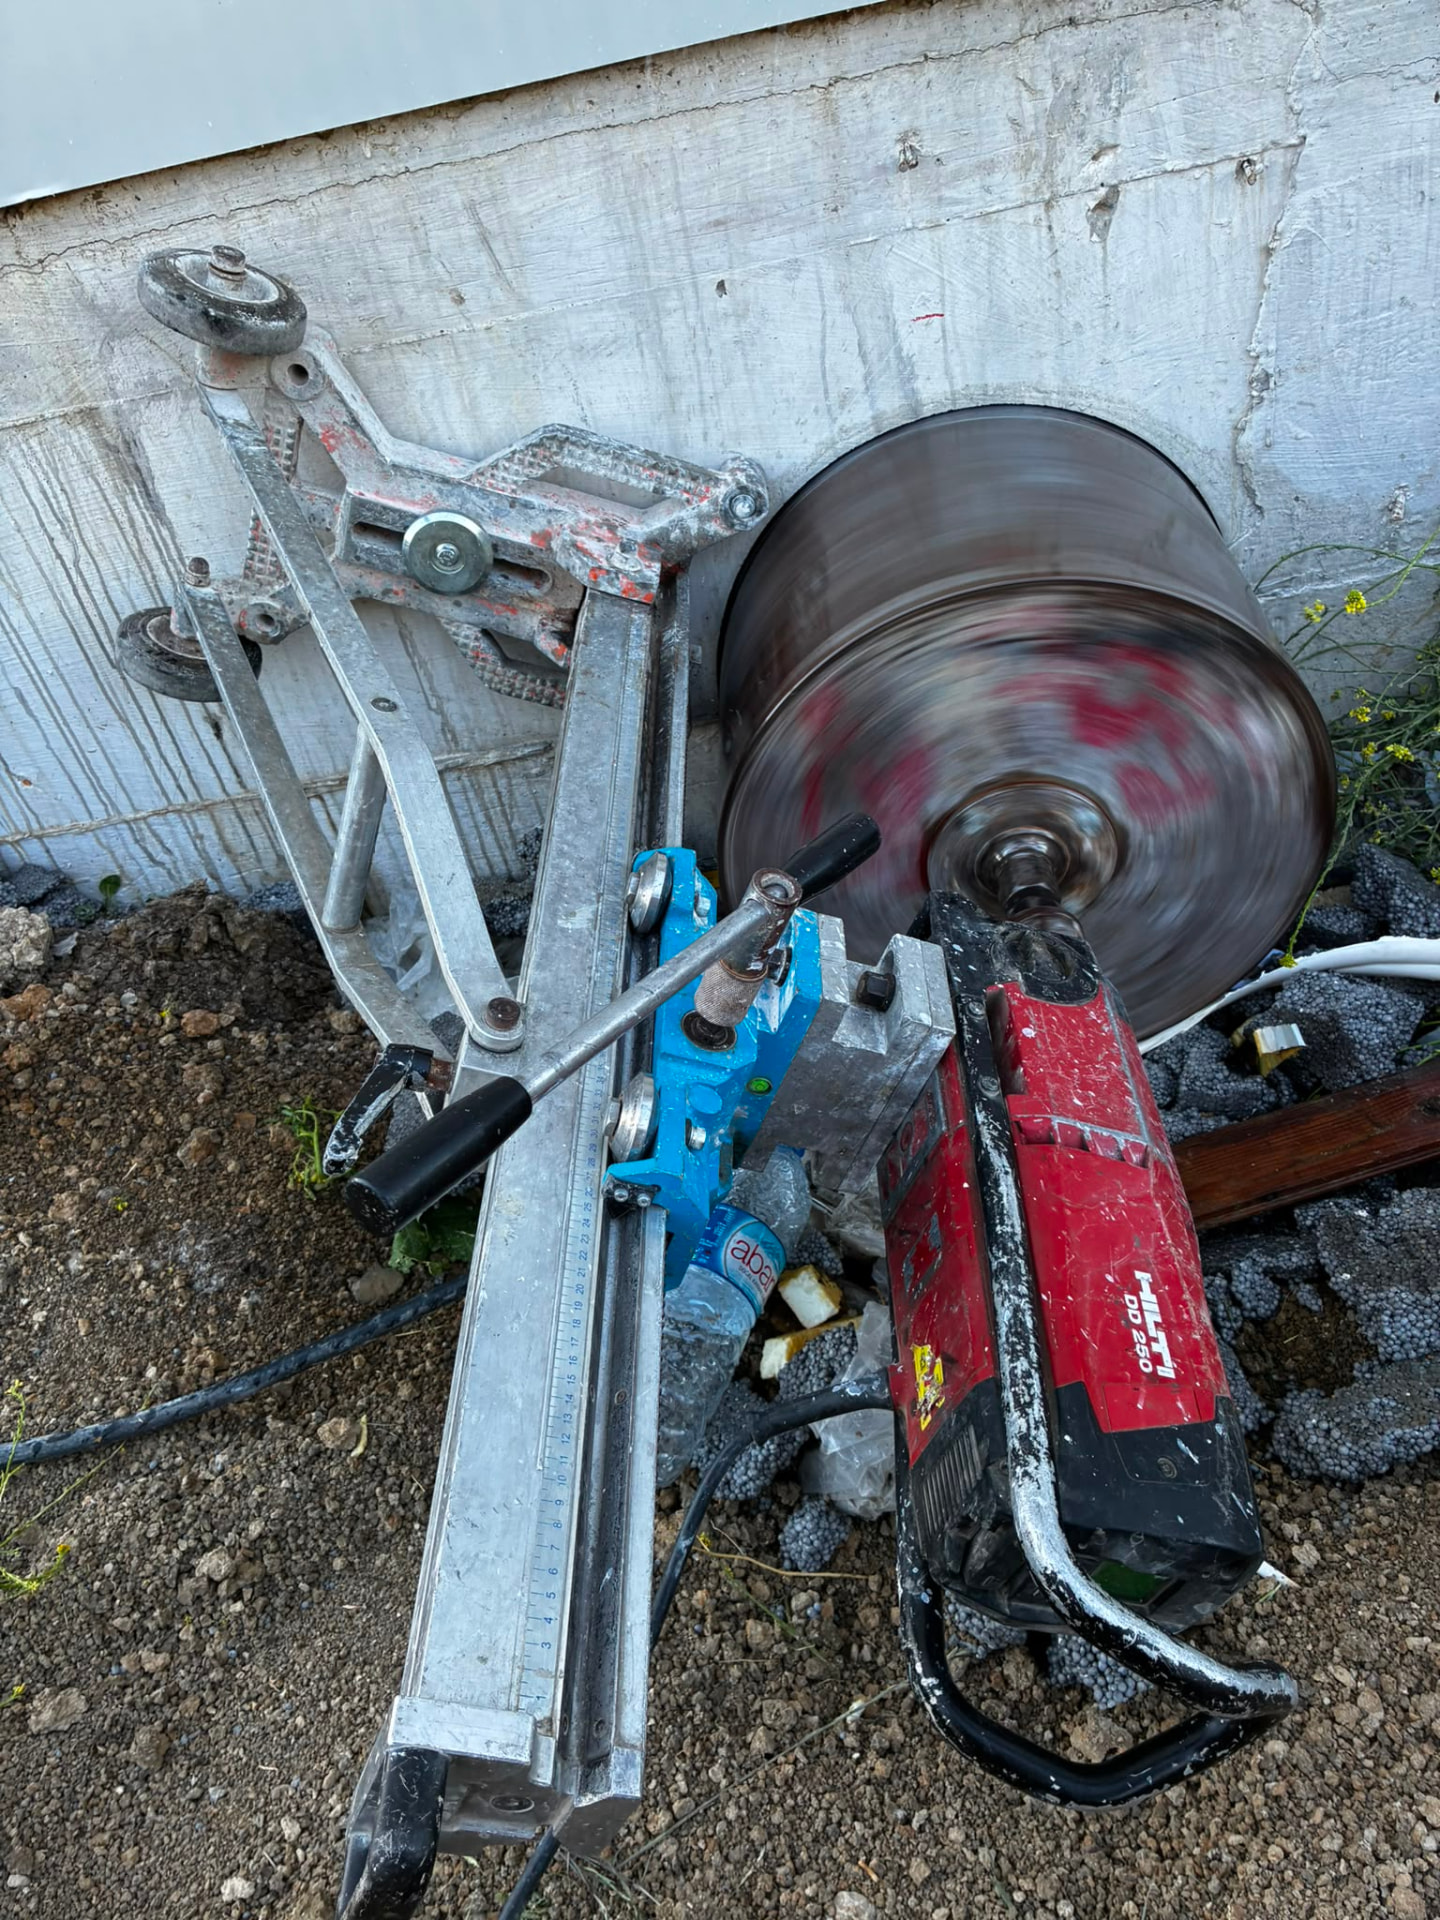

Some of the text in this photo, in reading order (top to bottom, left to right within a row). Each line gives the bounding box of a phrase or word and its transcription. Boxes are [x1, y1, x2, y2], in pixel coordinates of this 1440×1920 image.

[588, 1142, 598, 1153] 29
[587, 1157, 596, 1167] 28
[583, 1201, 593, 1212] 25
[582, 1218, 591, 1228] 24
[580, 1233, 590, 1244] 23
[579, 1250, 588, 1261] 22
[577, 1267, 586, 1278] 21
[575, 1283, 585, 1295] 20
[574, 1300, 583, 1311] 19
[572, 1318, 581, 1329] 18
[1134, 1270, 1176, 1379] HILTI
[1124, 1293, 1153, 1374] DD 250
[570, 1336, 579, 1347] 17
[568, 1355, 578, 1366] 16
[566, 1374, 577, 1385] 15
[565, 1393, 574, 1404] 14
[563, 1413, 573, 1424] 13
[561, 1432, 571, 1444] 12
[559, 1455, 569, 1464] 11
[557, 1474, 567, 1486] 10
[552, 1521, 563, 1529] 8
[548, 1567, 559, 1576] 6
[545, 1591, 556, 1600] 5
[543, 1616, 553, 1625] 4
[541, 1641, 552, 1650] 3
